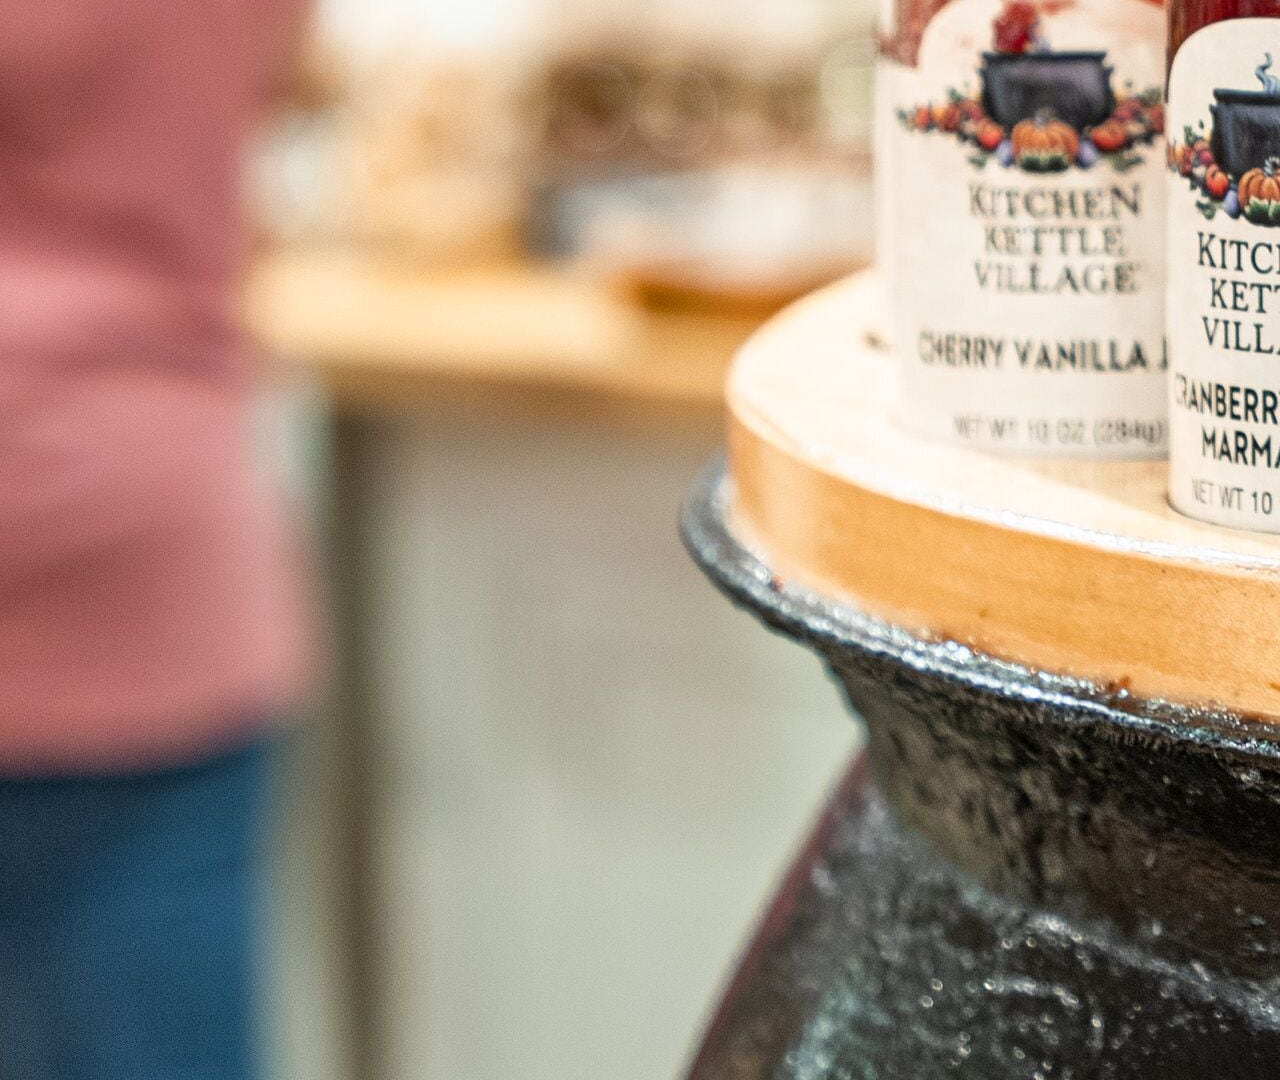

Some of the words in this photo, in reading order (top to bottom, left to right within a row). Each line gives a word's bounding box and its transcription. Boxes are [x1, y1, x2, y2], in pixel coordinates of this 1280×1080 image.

[969, 181, 1141, 220] KITCHEN
[985, 224, 1126, 257] KETTLE
[918, 329, 1004, 368] CHERRY
[1014, 337, 1148, 372] VANILLA
[1191, 475, 1214, 505] NET
[1219, 484, 1244, 511] WT
[1251, 491, 1273, 516] 10
